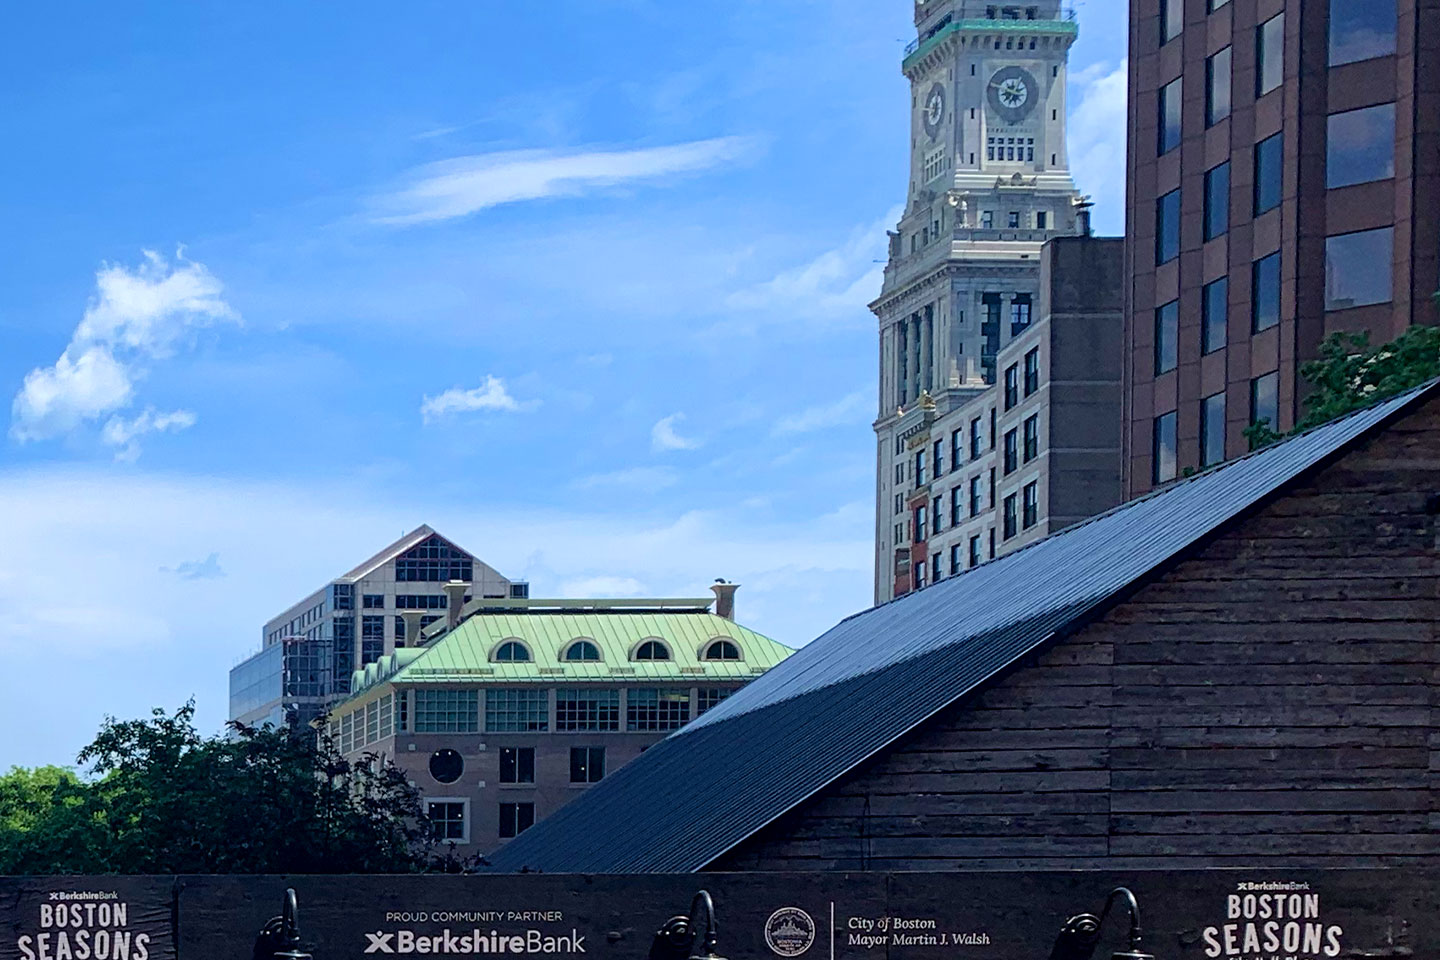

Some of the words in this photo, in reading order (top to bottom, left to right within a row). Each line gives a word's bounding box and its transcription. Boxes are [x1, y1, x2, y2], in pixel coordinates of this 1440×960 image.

[60, 891, 118, 900] BerkshireBank
[40, 903, 127, 928] BOSTON
[1227, 893, 1319, 919] BOSTON
[386, 911, 428, 922] PROUD
[431, 911, 504, 922] COMMUNITY
[507, 911, 563, 922] PARTNER
[848, 917, 874, 932] City
[877, 916, 891, 932] of
[893, 917, 936, 929] Boston
[397, 929, 586, 954] BerkshireBank
[848, 933, 888, 948] Mayor
[892, 933, 937, 945] Martin
[939, 933, 948, 945] J.
[952, 933, 990, 945] Walsh
[1203, 921, 1343, 957] SEASONS
